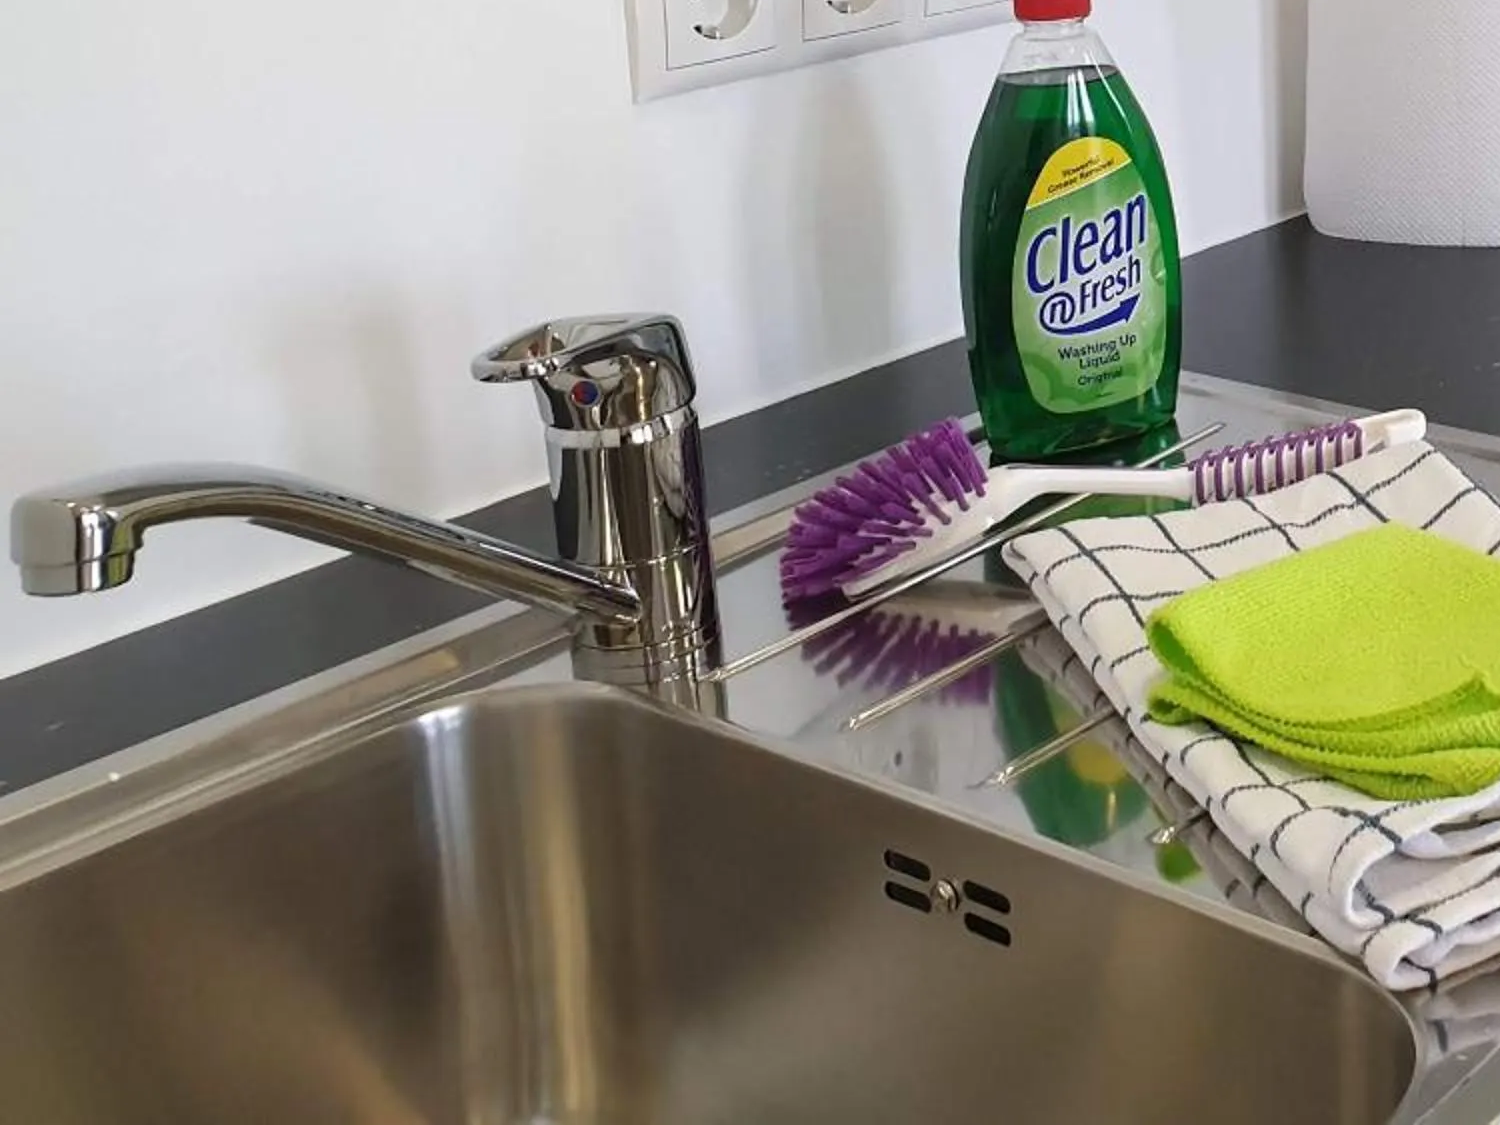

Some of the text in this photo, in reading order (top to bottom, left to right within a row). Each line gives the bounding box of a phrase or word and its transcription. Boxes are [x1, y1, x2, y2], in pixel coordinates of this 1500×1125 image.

[1027, 193, 1146, 294] Clean
[1079, 255, 1141, 315] Fresh
[1057, 334, 1137, 361] Washing Up
[1079, 350, 1121, 370] Liquid
